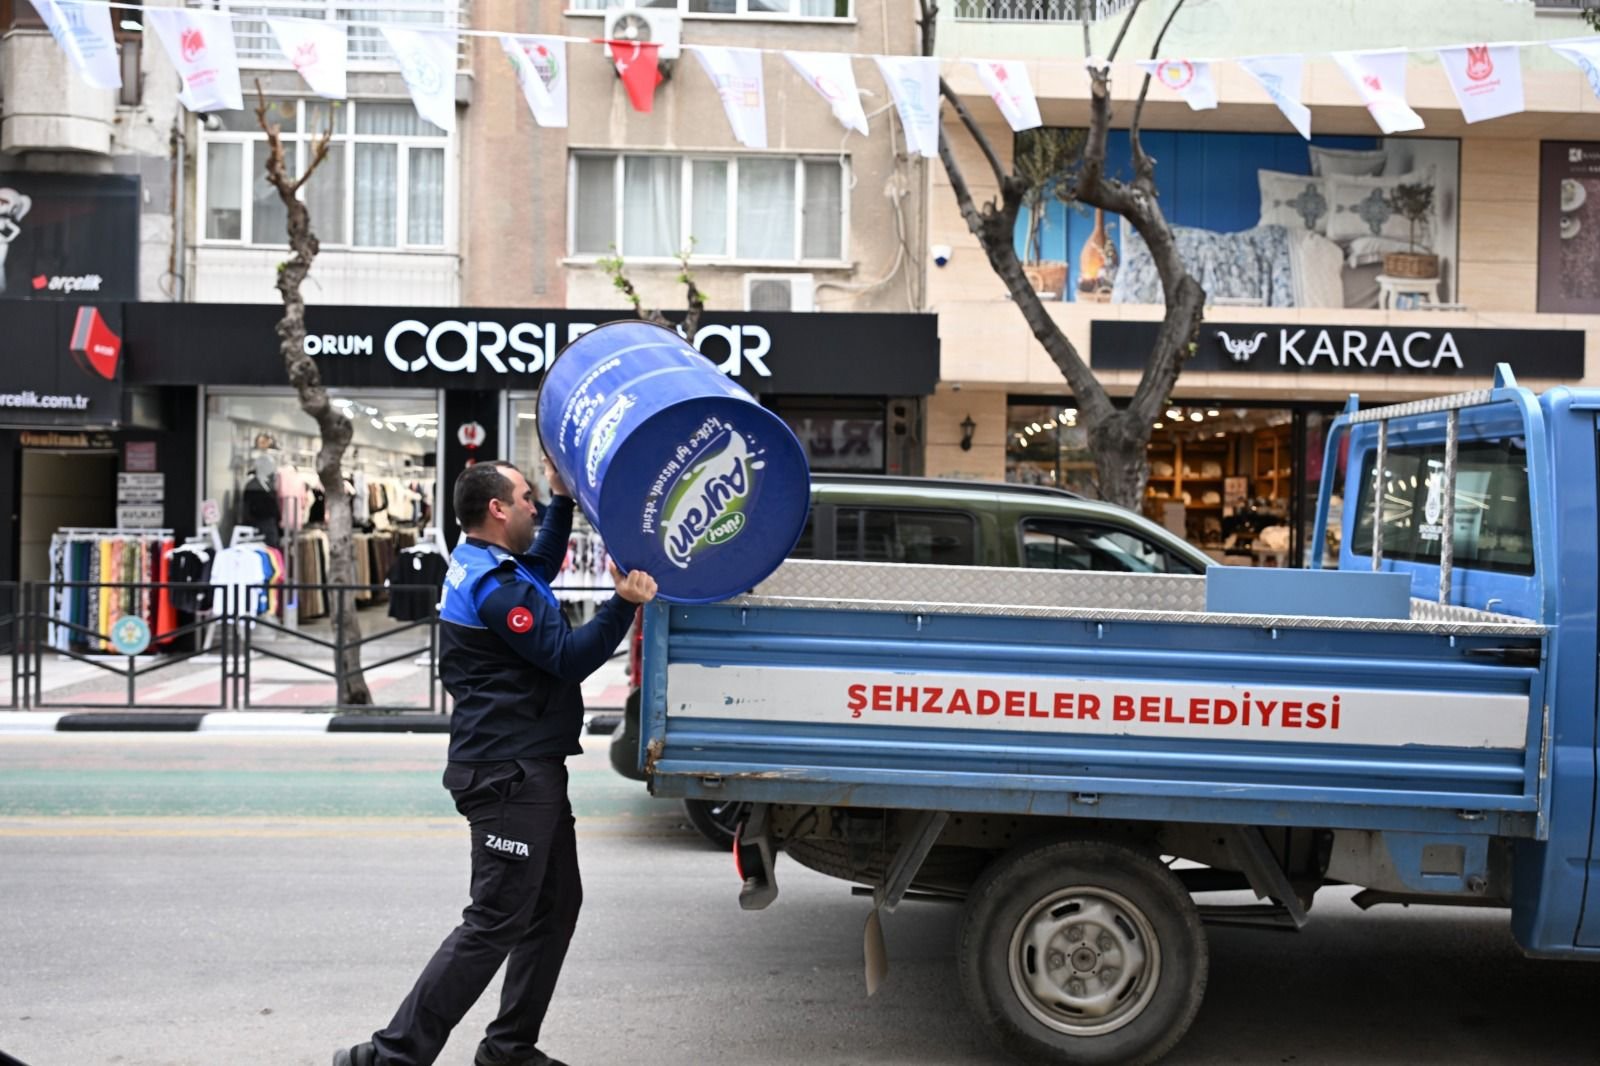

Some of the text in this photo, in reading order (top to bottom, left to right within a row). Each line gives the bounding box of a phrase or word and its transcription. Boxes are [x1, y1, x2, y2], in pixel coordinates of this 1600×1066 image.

[303, 334, 373, 356] ORUM
[1279, 328, 1465, 369] KARACA
[0, 390, 90, 410] rcelik.com.tr
[676, 445, 693, 464] iyi
[642, 459, 681, 535] hissedeeksin!
[669, 456, 746, 556] Ayran
[847, 683, 1341, 731] ŞEHZADELER BELEDİYESİ
[485, 834, 530, 857] ZABITA
